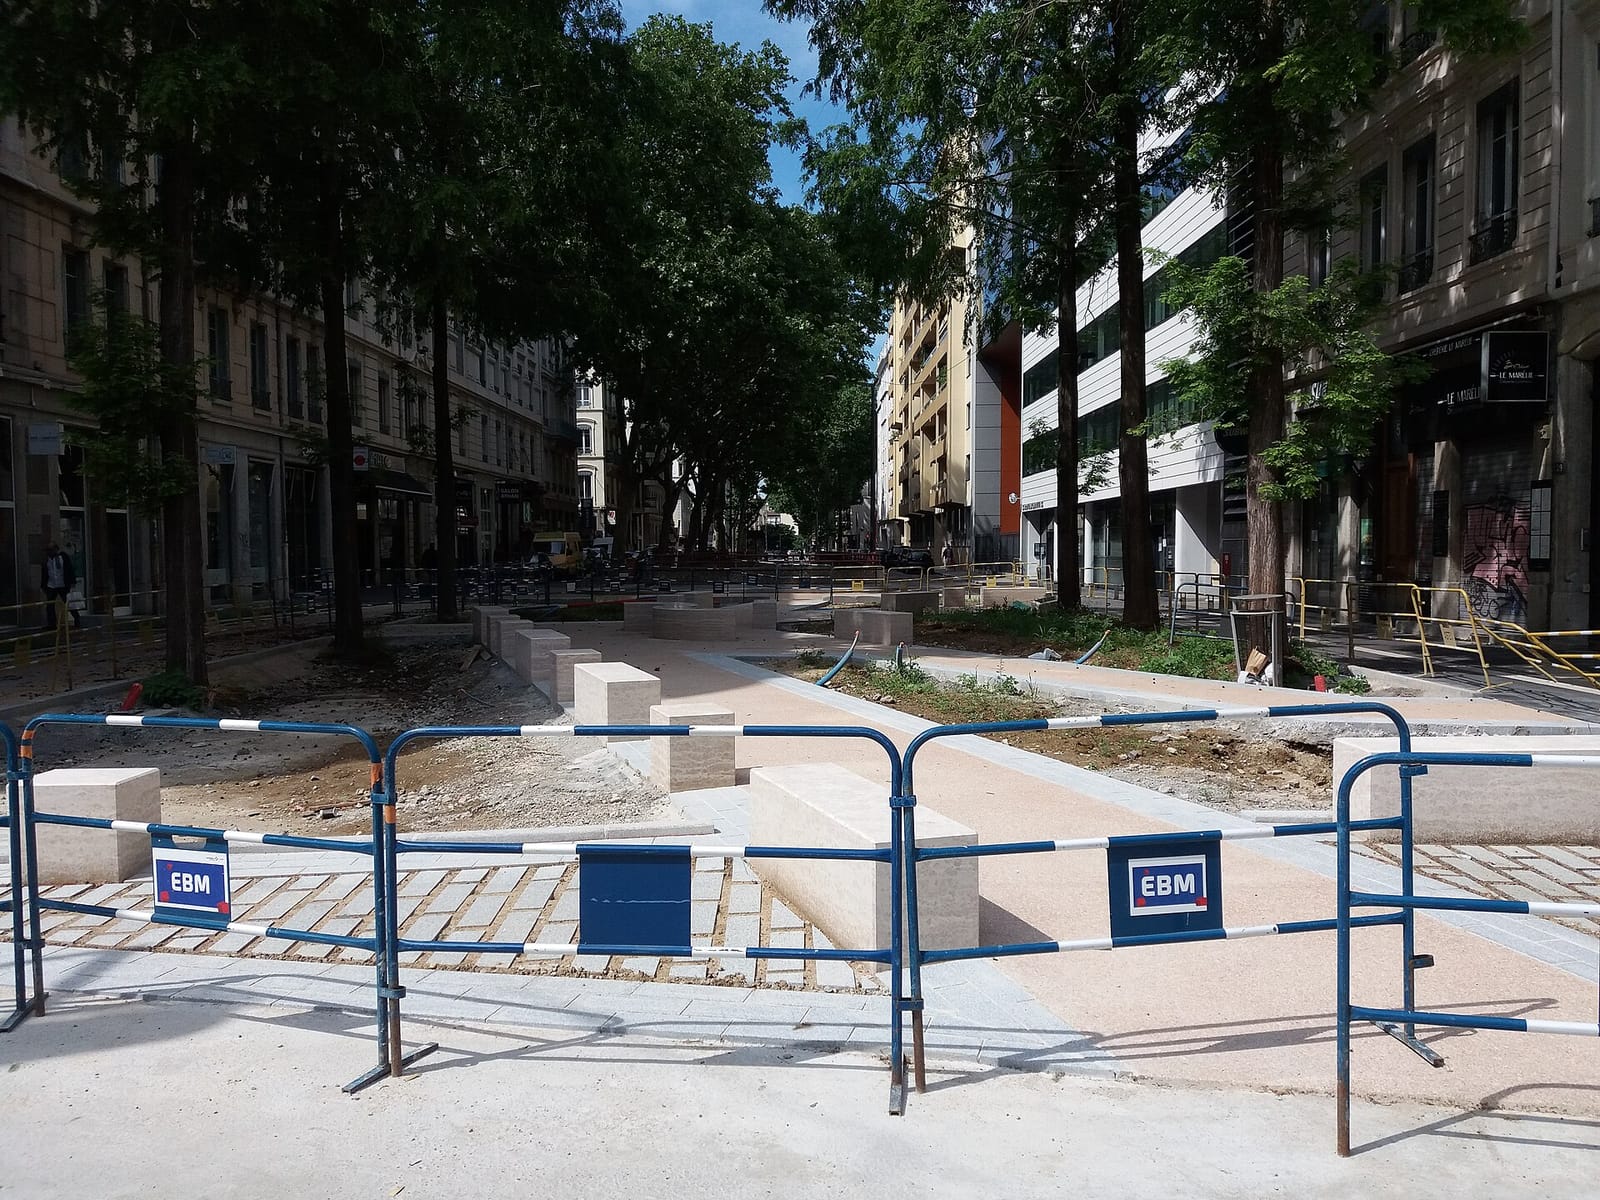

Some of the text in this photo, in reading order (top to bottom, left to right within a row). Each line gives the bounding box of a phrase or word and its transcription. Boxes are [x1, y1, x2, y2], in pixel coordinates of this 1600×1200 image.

[1499, 371, 1507, 379] LE
[1447, 391, 1455, 405] LE
[171, 872, 211, 895] EBM
[1141, 873, 1196, 897] EBM
